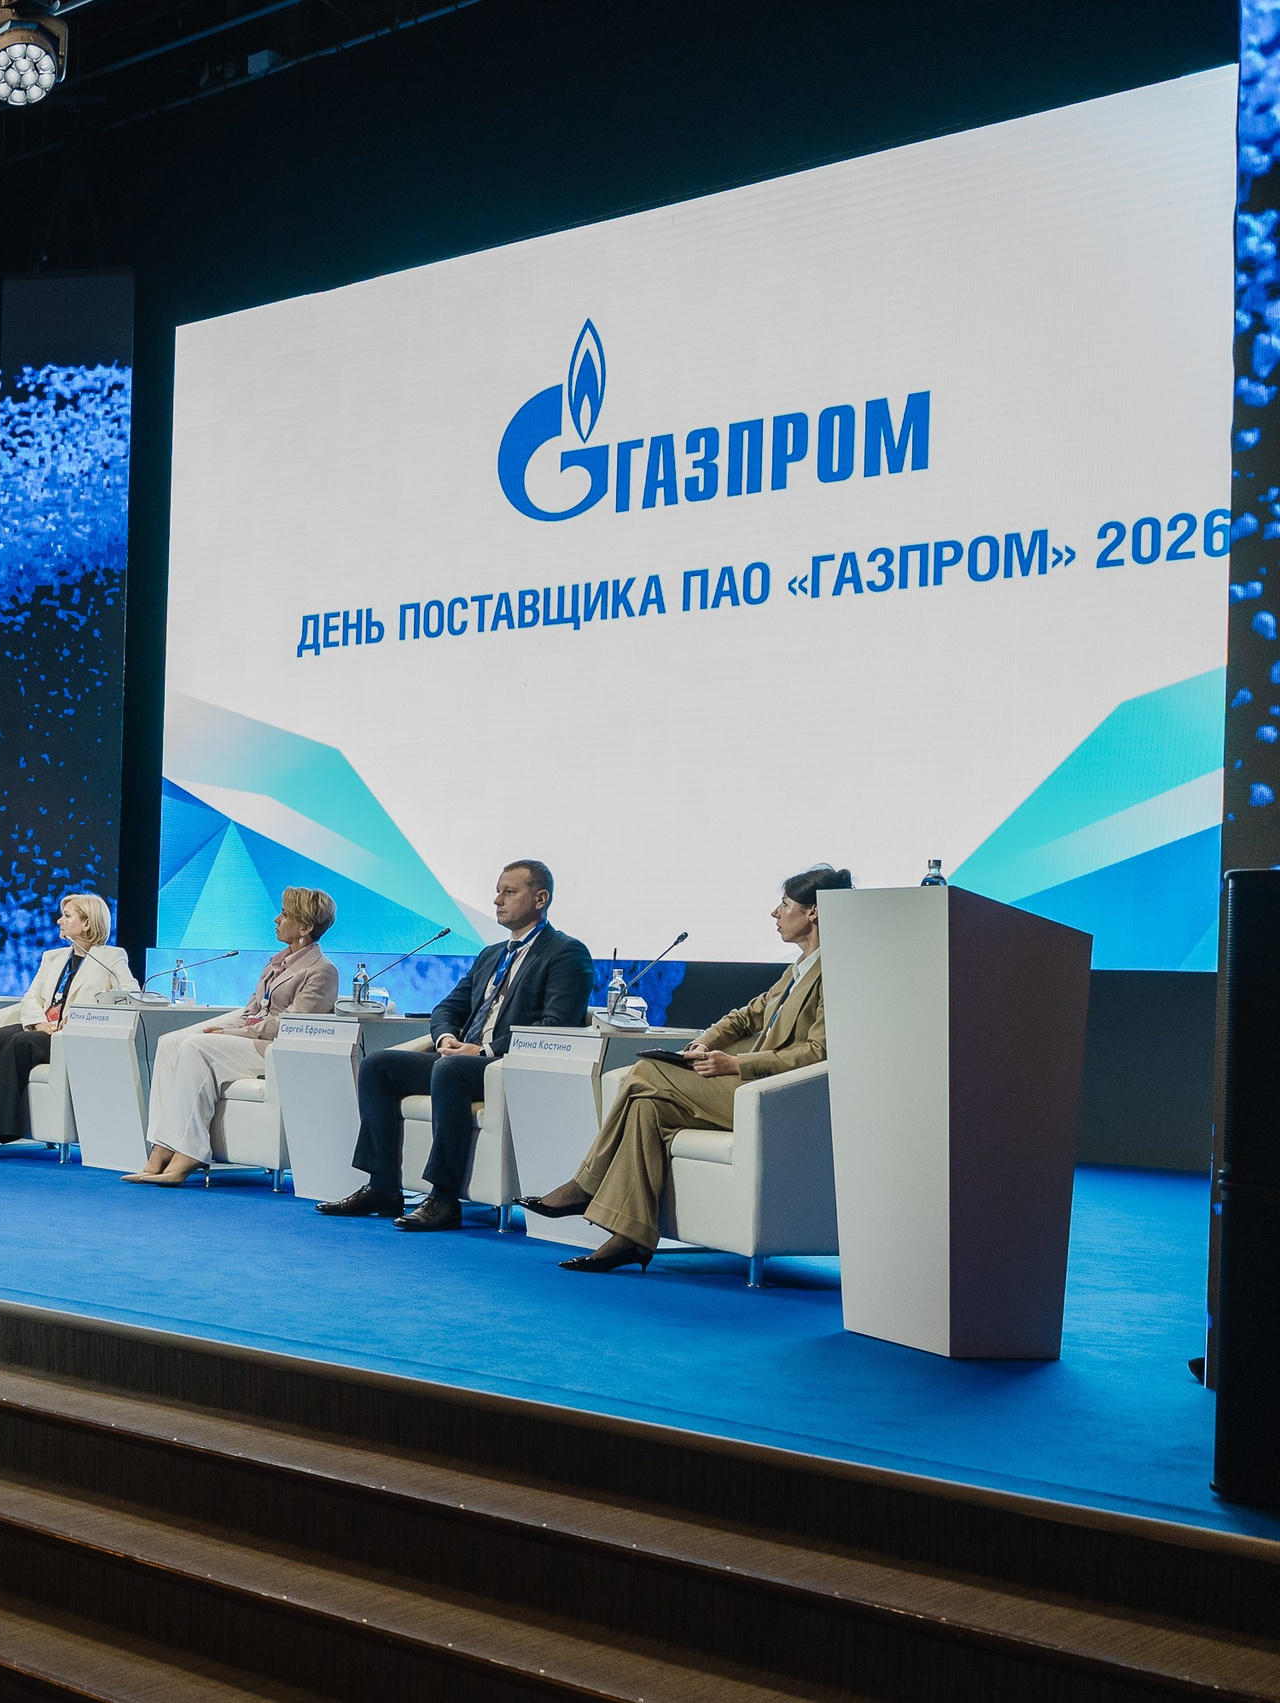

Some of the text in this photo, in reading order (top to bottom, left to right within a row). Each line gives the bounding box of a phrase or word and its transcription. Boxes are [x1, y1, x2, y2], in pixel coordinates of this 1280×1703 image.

[615, 390, 931, 513] ГАЗПРОМ
[296, 508, 1231, 658] ДЕНЬ ПОСТАВЩИКА ПАО «ГАЗПРОМ» 2026
[280, 1023, 335, 1036] Сергей Ефремов
[512, 1038, 572, 1052] Ирина Костина
